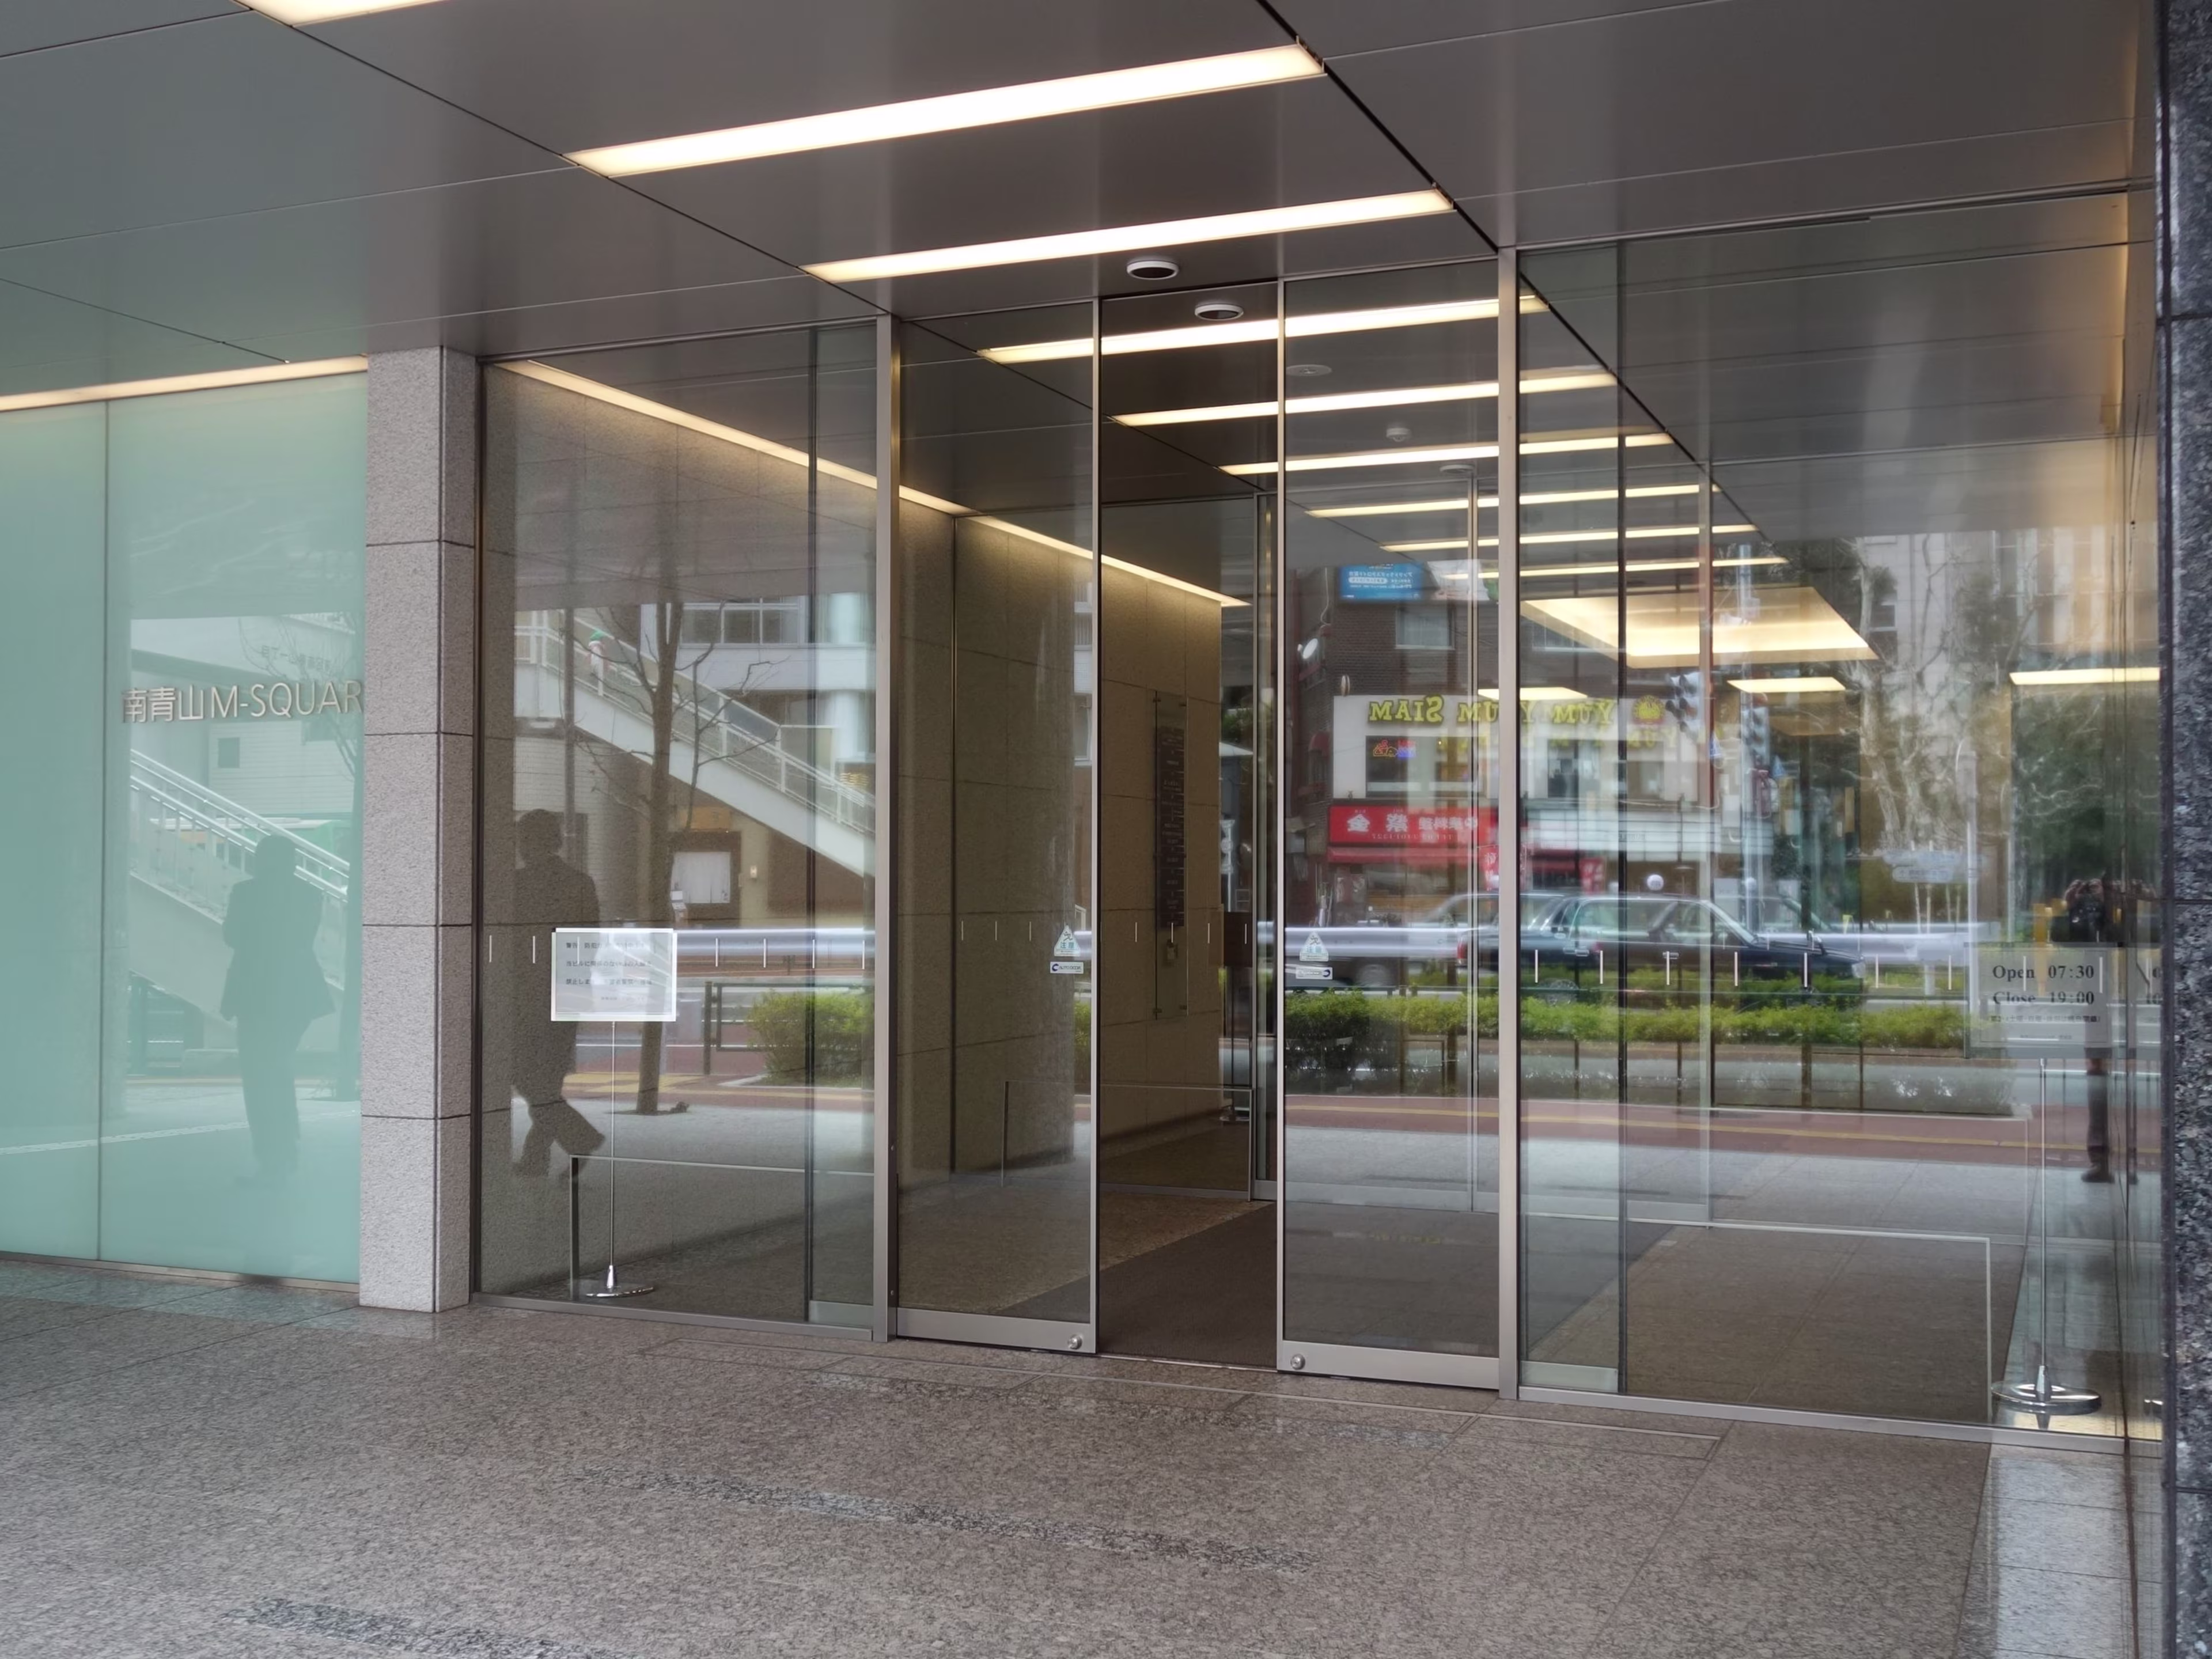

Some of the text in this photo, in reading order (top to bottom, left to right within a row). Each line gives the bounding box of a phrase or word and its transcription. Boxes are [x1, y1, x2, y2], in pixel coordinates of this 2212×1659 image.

[1993, 965, 2094, 982] Open 07:30
[1993, 991, 2094, 1005] Close 19:00
